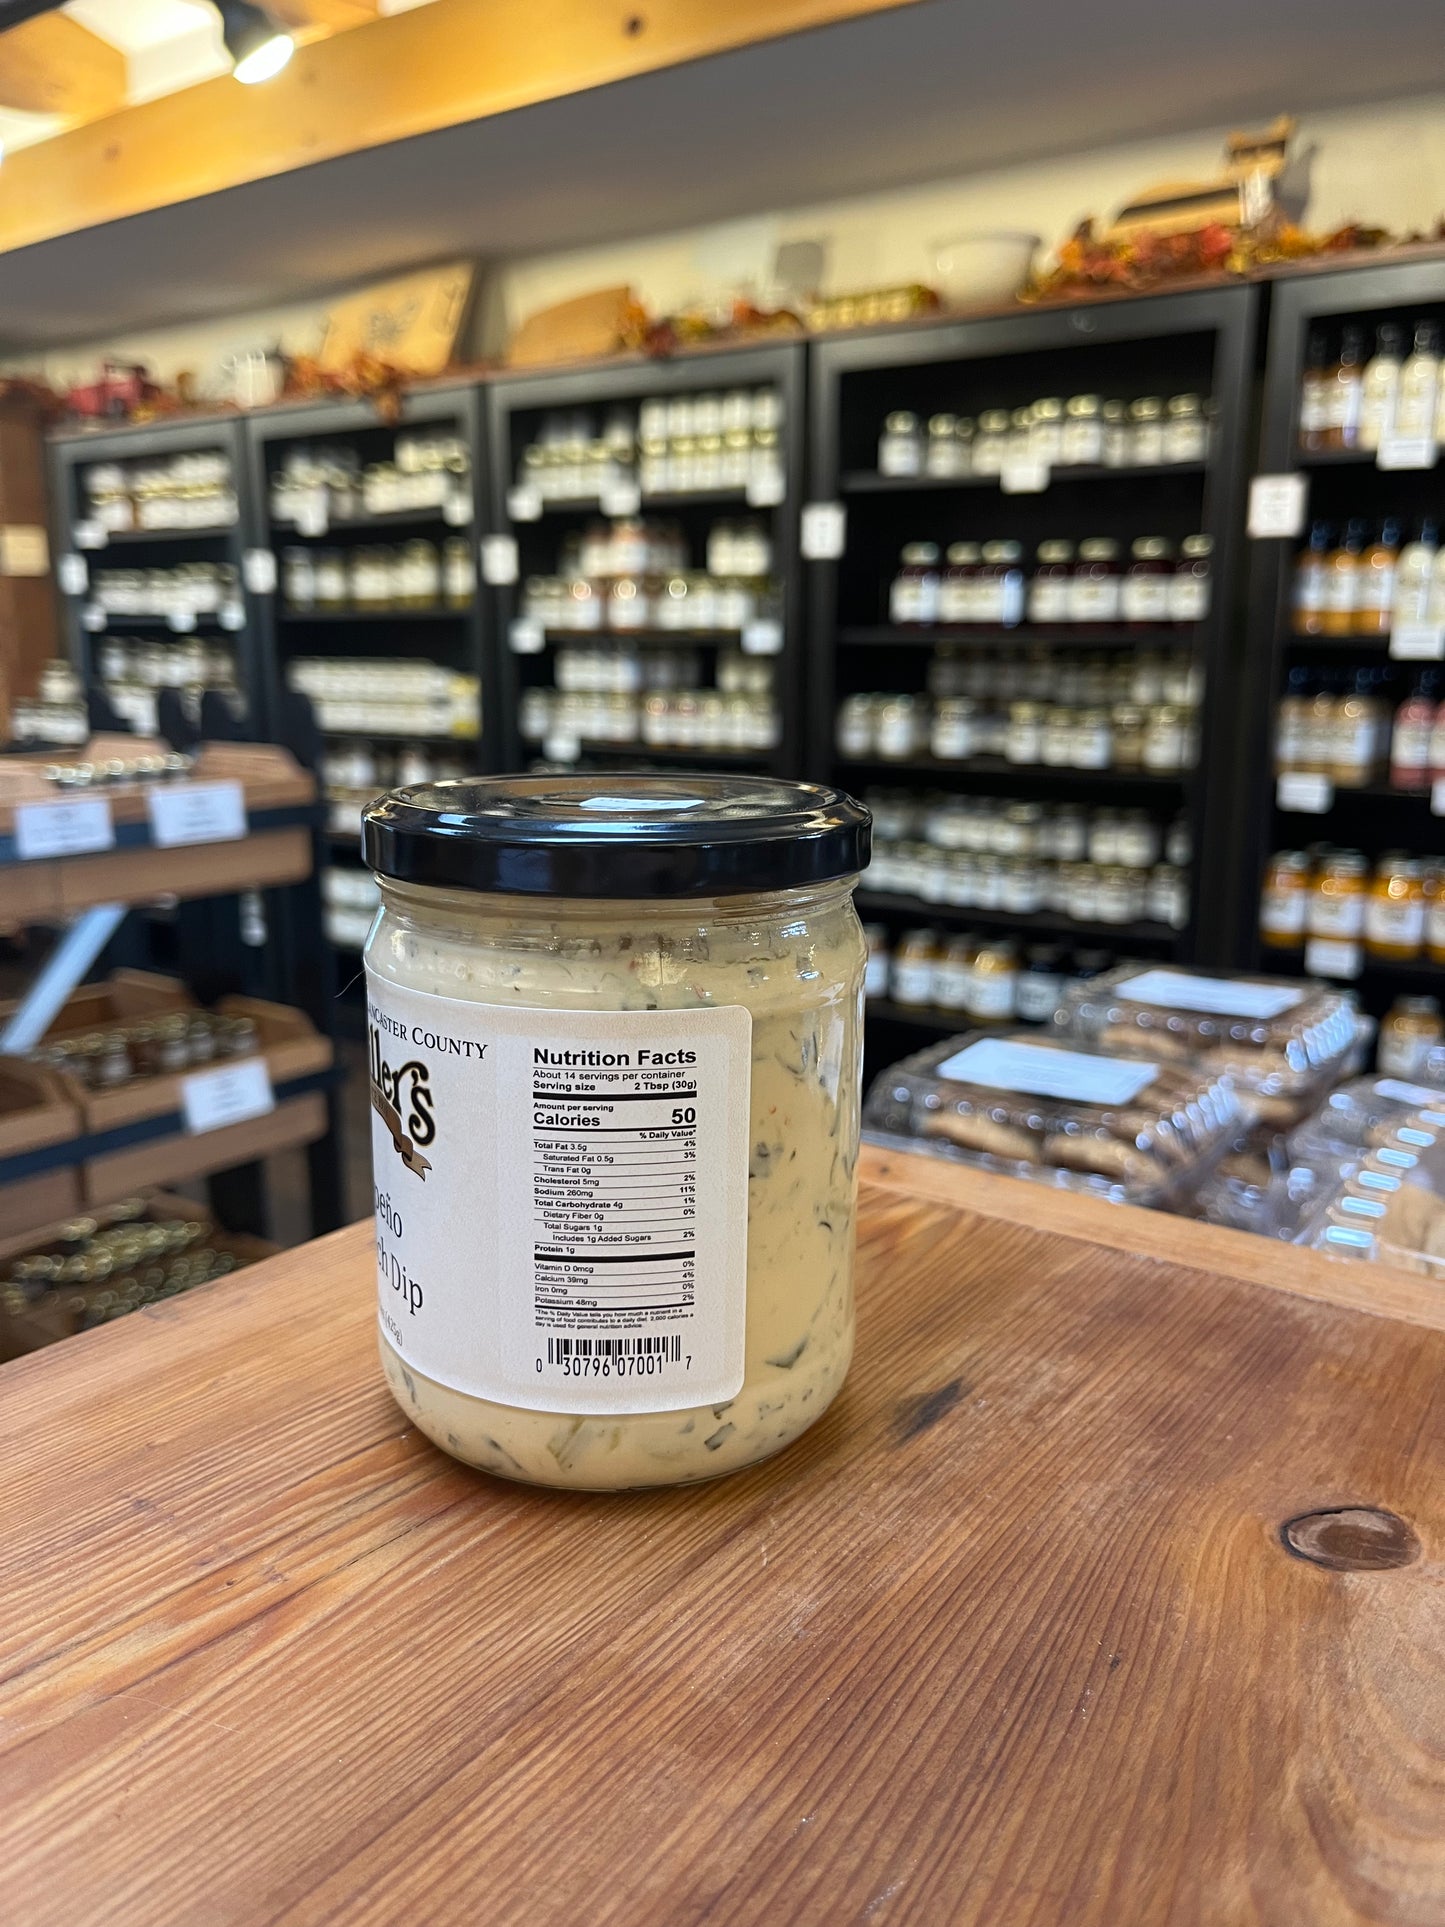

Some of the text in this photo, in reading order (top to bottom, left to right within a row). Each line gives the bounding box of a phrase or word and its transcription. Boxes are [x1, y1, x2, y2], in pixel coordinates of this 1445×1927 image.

[412, 1027, 488, 1059] COUNTY
[534, 1048, 697, 1066] Nutrition Facts
[533, 1070, 561, 1079] About
[579, 1072, 619, 1082] servings
[622, 1073, 638, 1081] per
[641, 1071, 685, 1079] container
[533, 1081, 571, 1092] Serving
[575, 1083, 596, 1091] size
[644, 1082, 669, 1091] Tbsp
[672, 1080, 697, 1091] (30g)
[534, 1107, 696, 1126] Calories 50
[649, 1132, 669, 1140] Daily
[543, 1154, 579, 1162] Saturated
[534, 1177, 580, 1185] Cholesterol
[583, 1178, 599, 1186] 5mg
[534, 1188, 565, 1196] Sodium
[544, 1211, 570, 1220] Dietary
[544, 1222, 561, 1230] Total
[564, 1223, 590, 1232] Sugars
[553, 1234, 584, 1242] Includes
[535, 1245, 575, 1254] Protein 1g
[535, 1263, 562, 1271] Vitamin
[392, 1253, 423, 1316] Dip
[535, 1297, 573, 1305] Potassium
[576, 1299, 597, 1307] 48mg
[536, 1355, 692, 1376] 0 30796 07001 7
